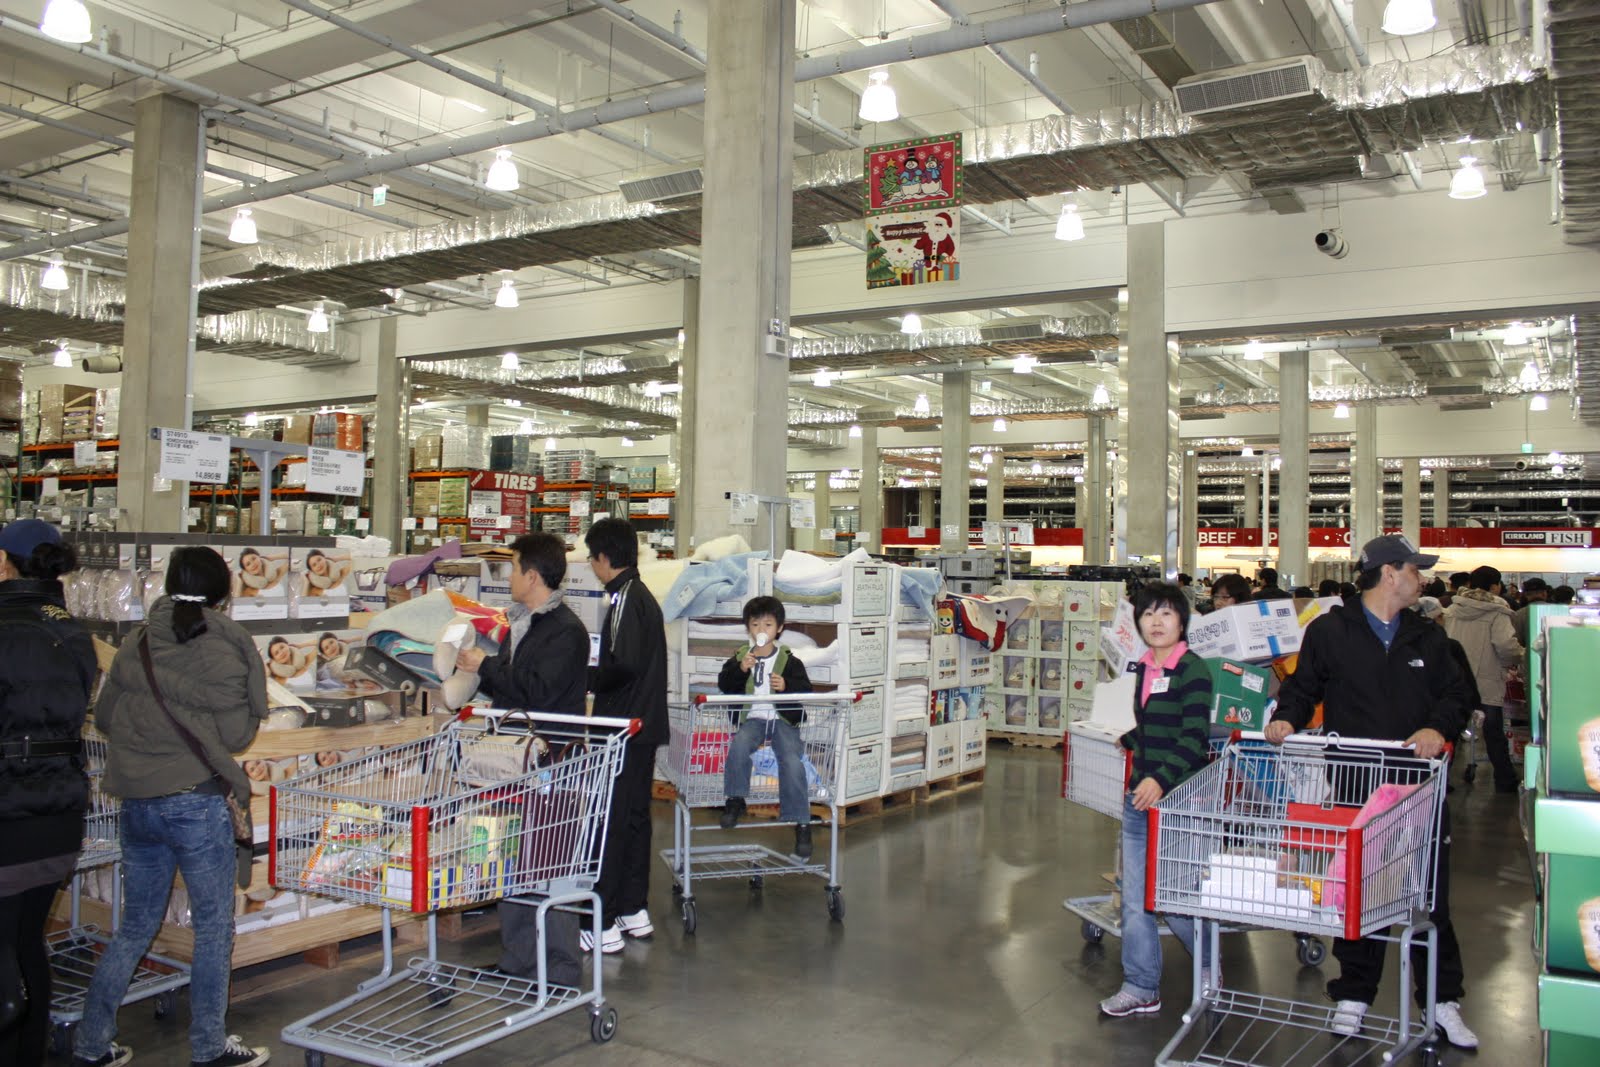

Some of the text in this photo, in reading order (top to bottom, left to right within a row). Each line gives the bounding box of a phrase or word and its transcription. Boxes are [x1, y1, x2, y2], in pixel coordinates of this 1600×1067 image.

[494, 472, 537, 491] TIRES
[1198, 532, 1237, 544] BEEF
[1551, 533, 1585, 543] FISH
[1066, 586, 1090, 597] Organic
[1071, 625, 1095, 636] Organic
